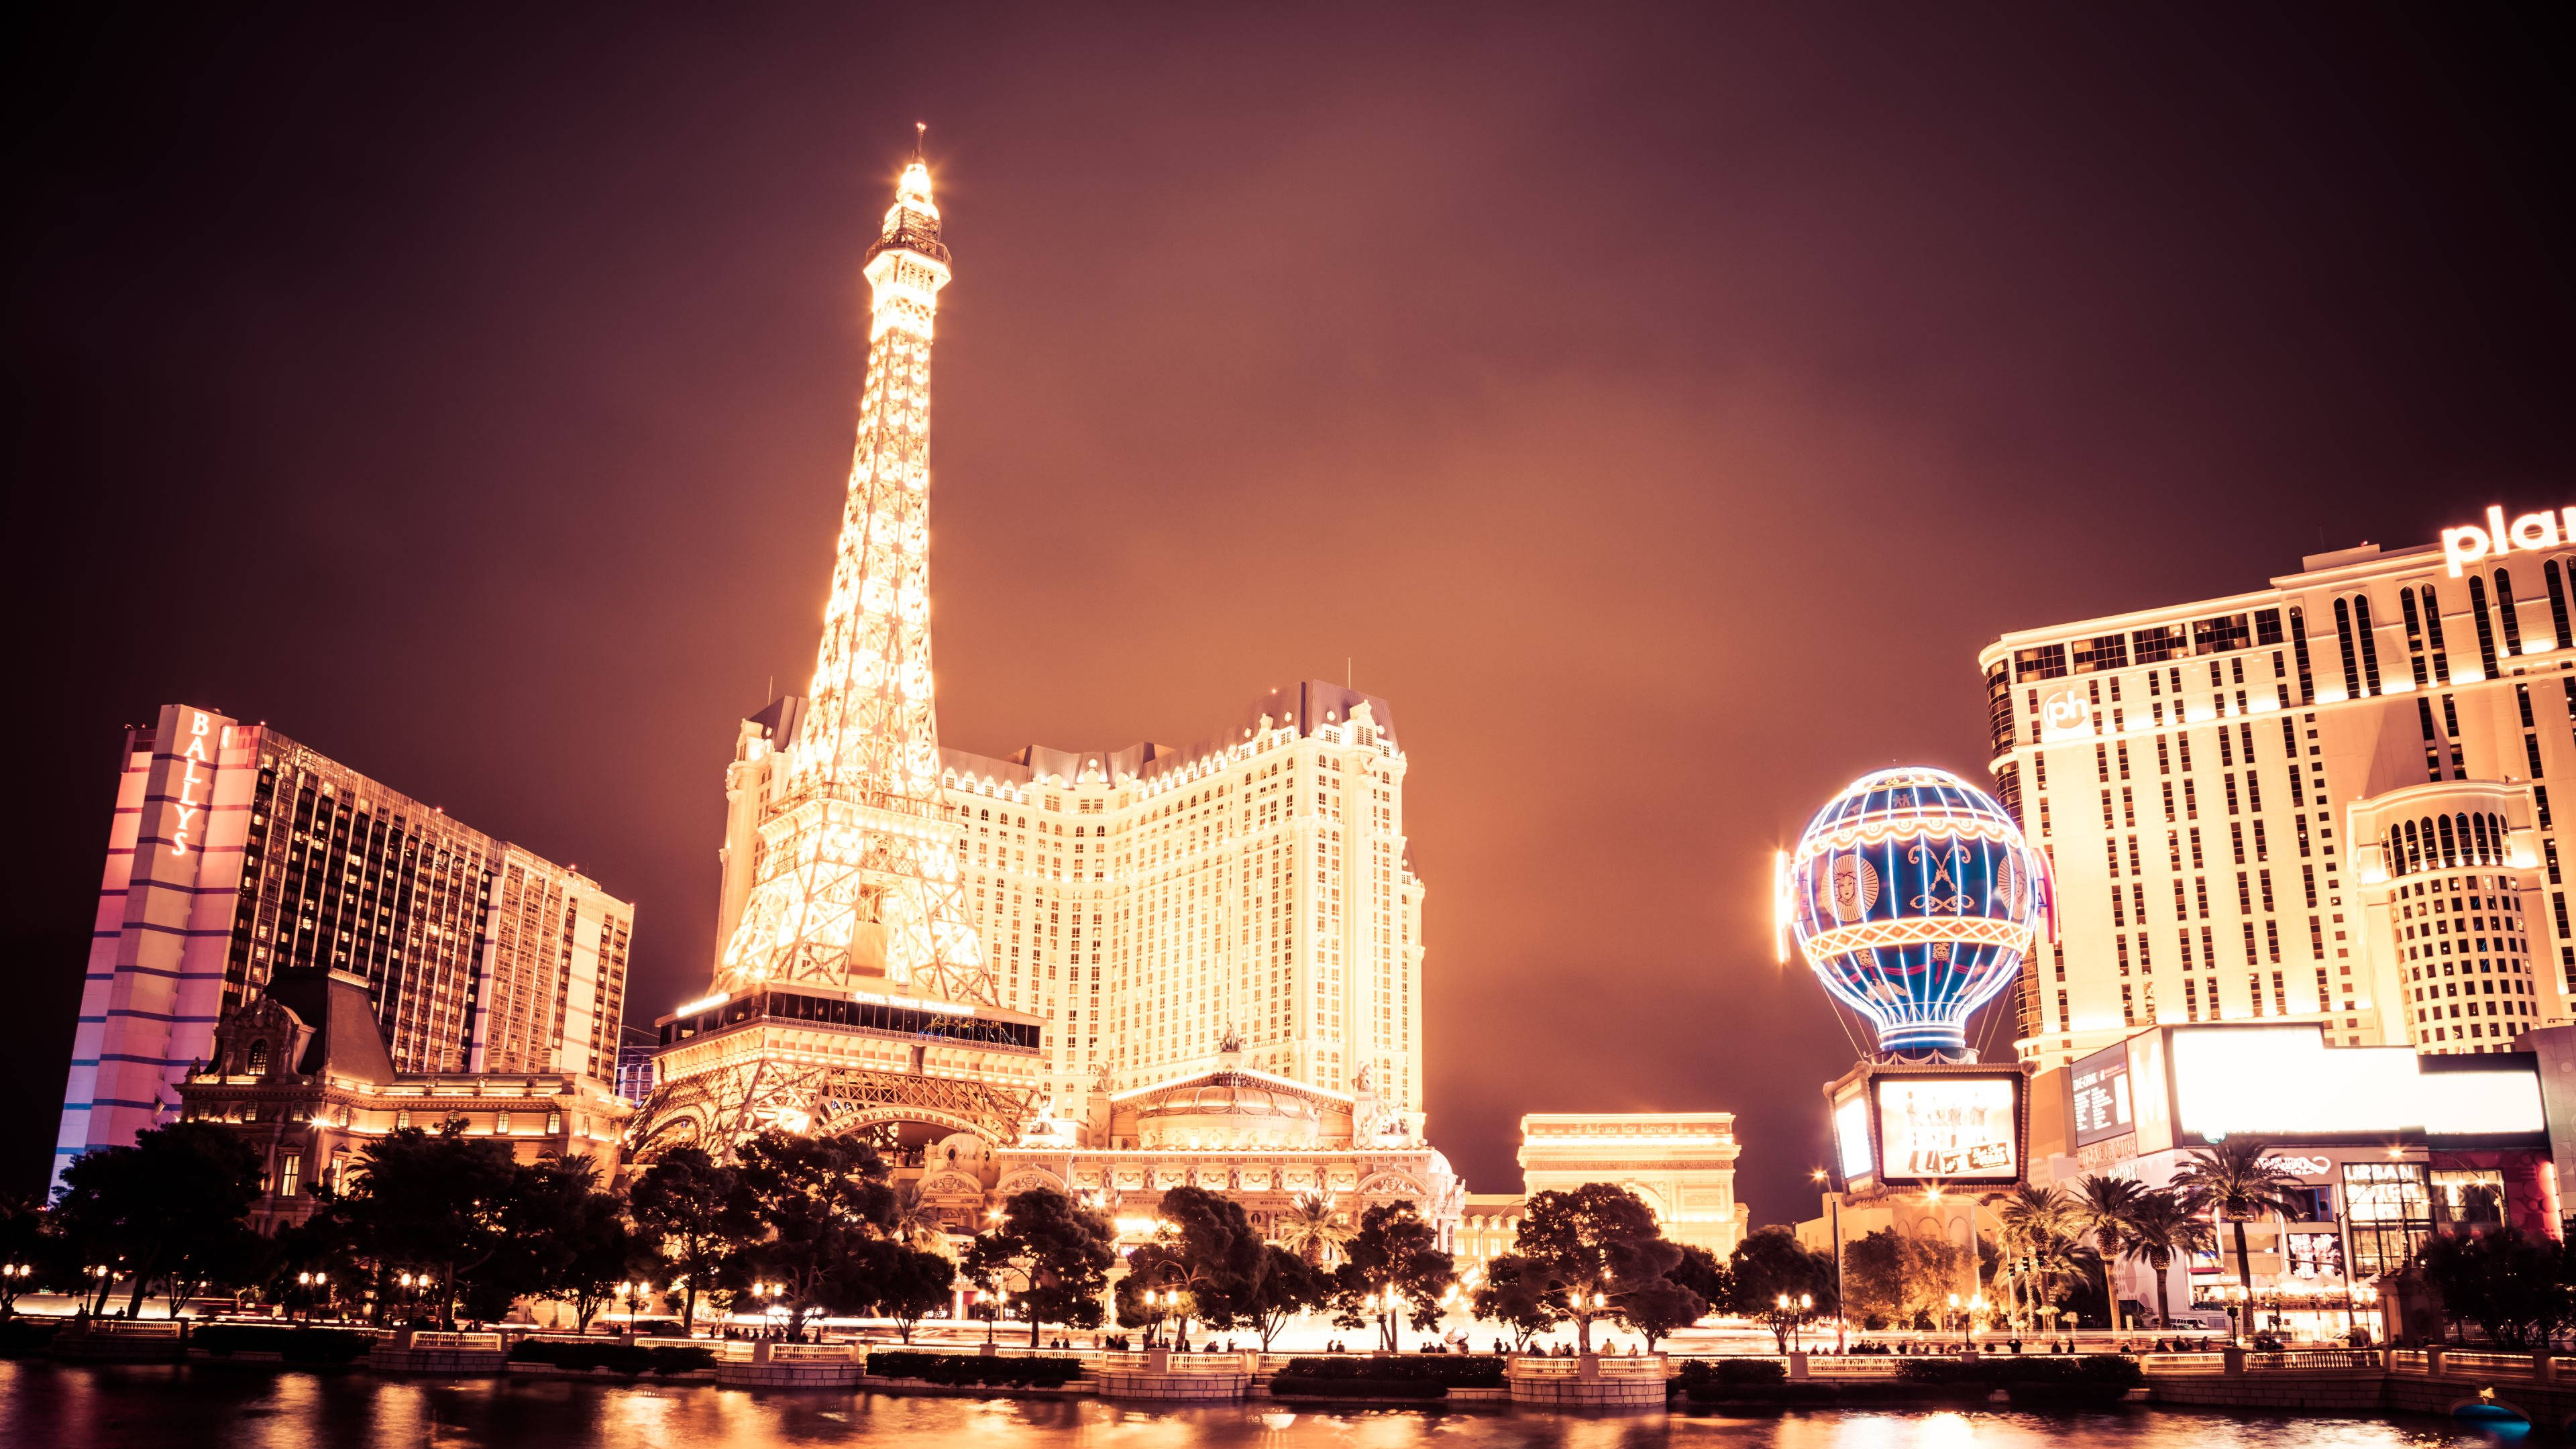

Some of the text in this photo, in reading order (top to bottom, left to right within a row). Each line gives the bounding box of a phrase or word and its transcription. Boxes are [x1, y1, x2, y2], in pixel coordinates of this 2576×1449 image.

[2049, 690, 2088, 729] ph
[171, 711, 210, 856] BALLYS
[2077, 1137, 2135, 1168] MIRACLE MILE
[2343, 1164, 2414, 1180] URBAN
